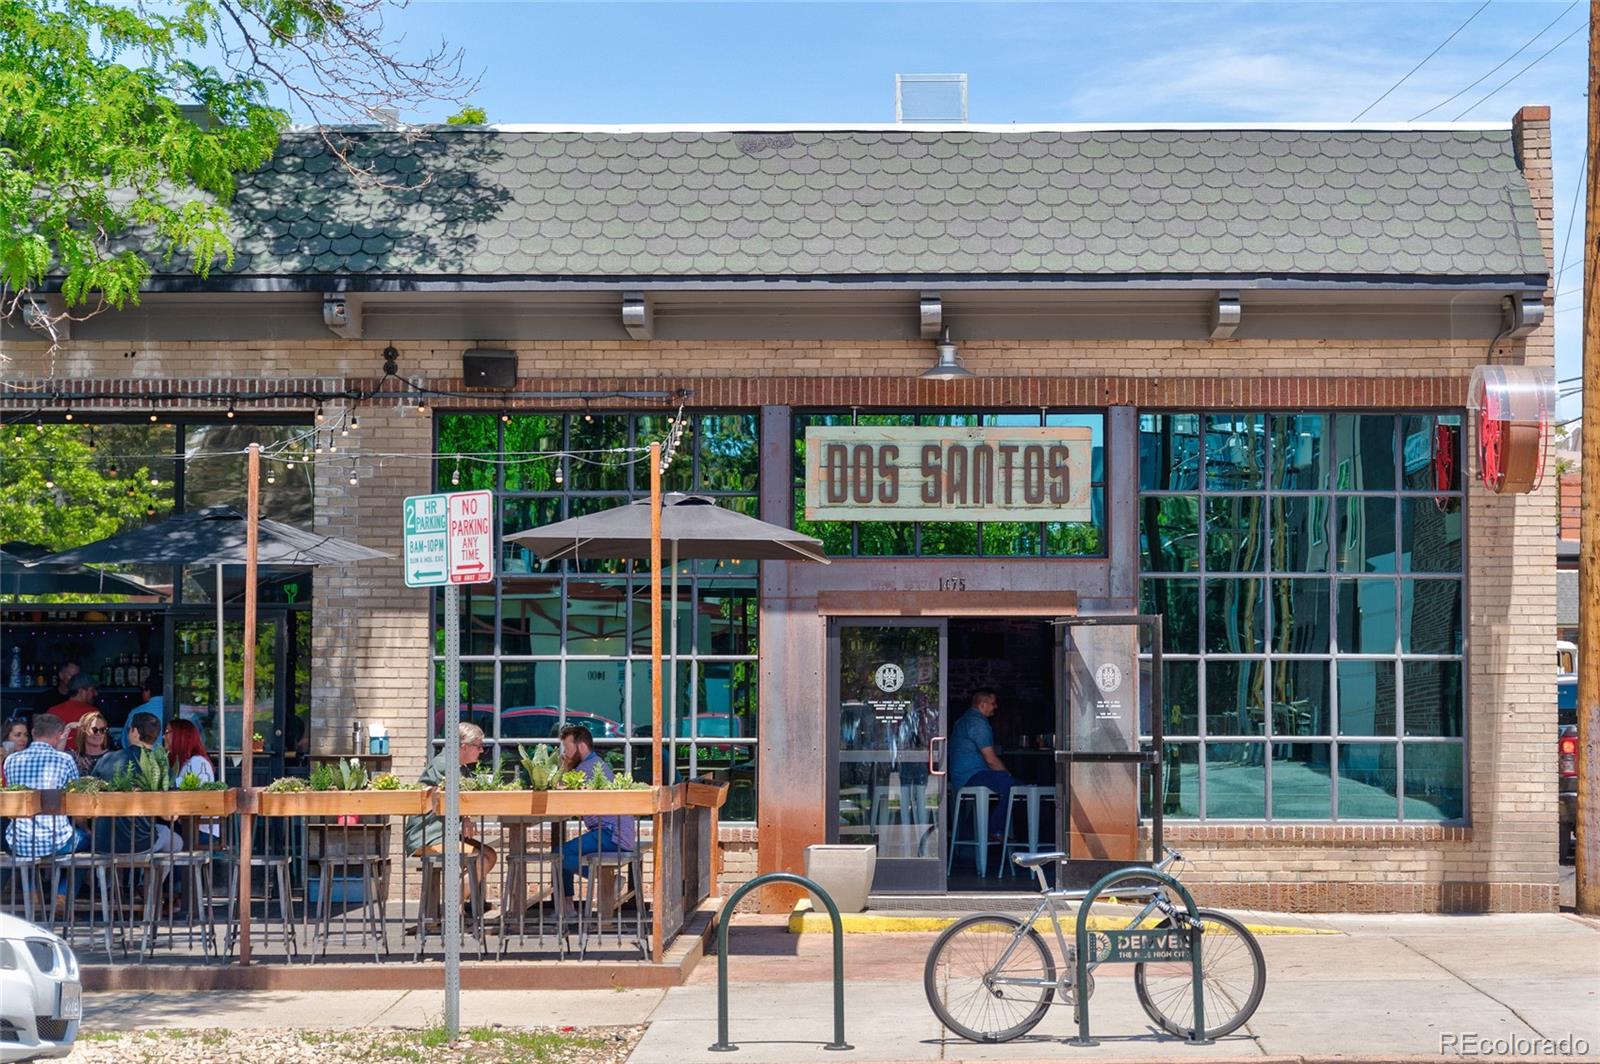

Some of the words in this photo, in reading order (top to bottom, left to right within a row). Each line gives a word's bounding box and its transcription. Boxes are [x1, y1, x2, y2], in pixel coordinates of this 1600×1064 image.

[827, 443, 899, 504] DOS
[921, 443, 1070, 505] SANTOS
[406, 505, 415, 529] 2
[424, 500, 437, 515] HR
[461, 498, 478, 516] NO
[416, 515, 446, 531] PARKING
[452, 517, 488, 537] PARKING
[409, 538, 444, 554] 8AM-10PM
[462, 536, 478, 549] ANY
[461, 548, 480, 561] TIME
[1117, 935, 1190, 949] DENVER
